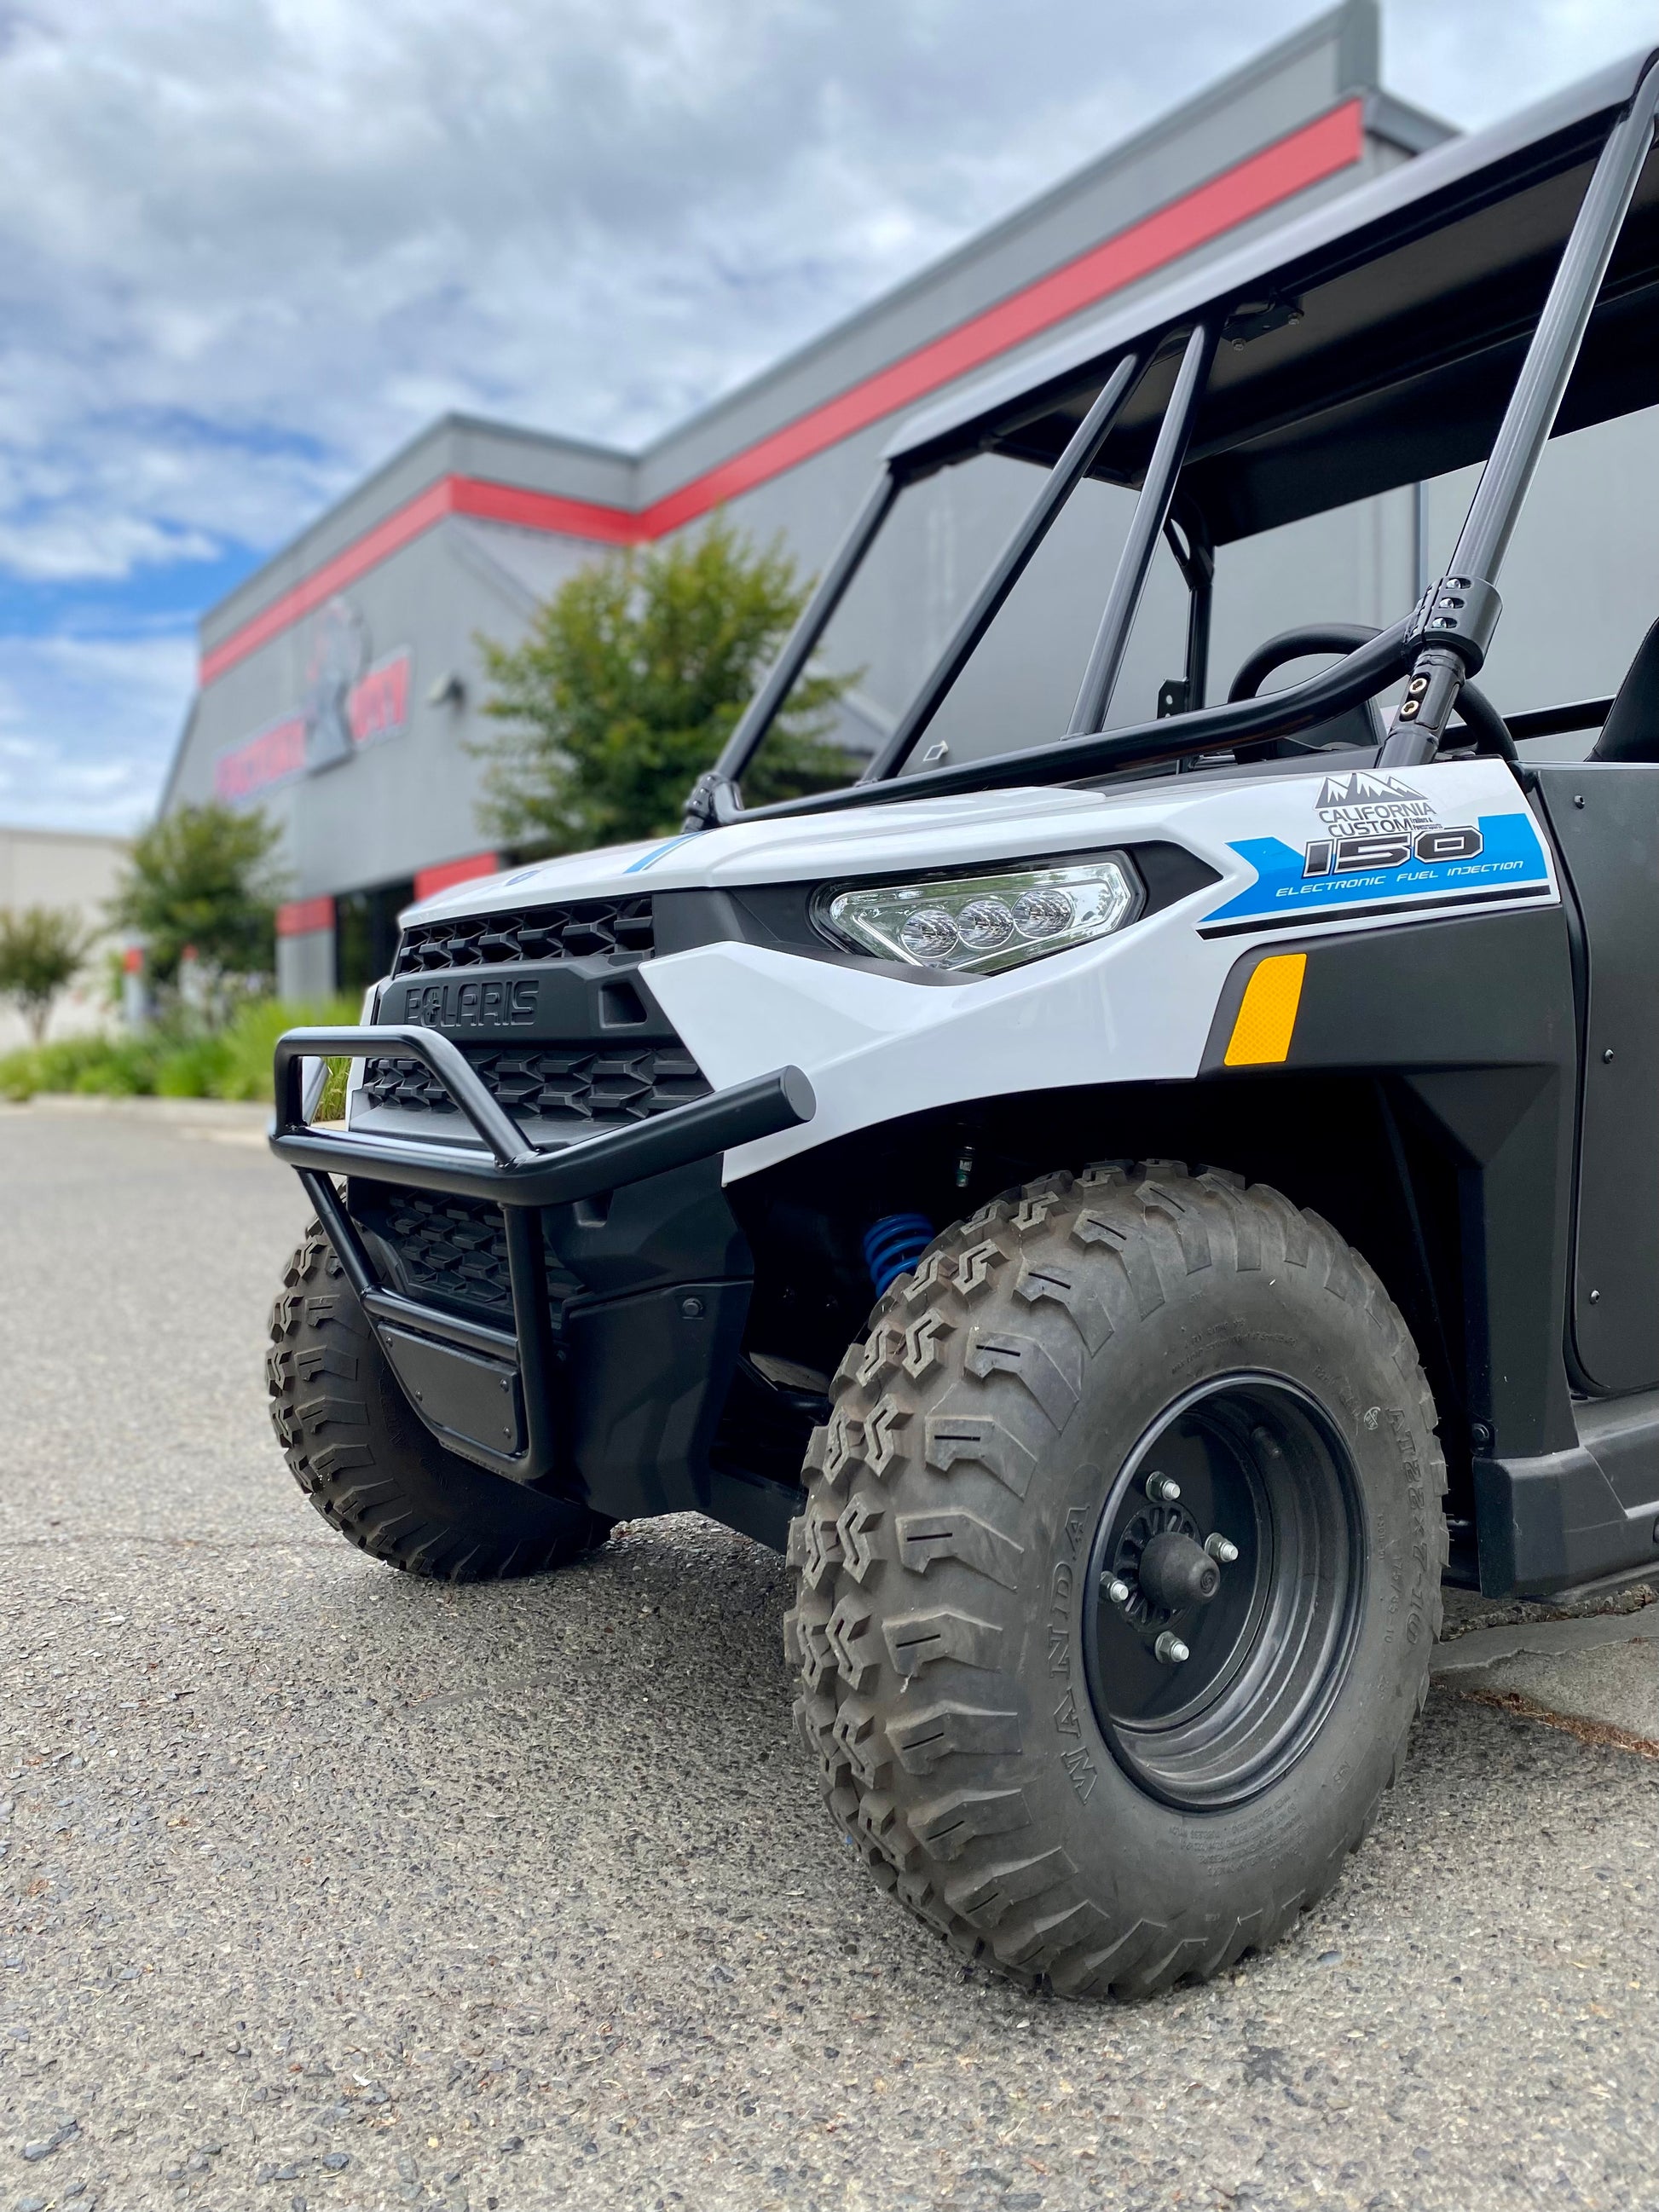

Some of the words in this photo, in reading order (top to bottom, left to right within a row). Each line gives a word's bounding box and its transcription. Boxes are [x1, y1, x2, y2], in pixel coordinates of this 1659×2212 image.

[1318, 801, 1437, 824] CALIFORNIA
[1327, 817, 1413, 838] CUSTOM
[1301, 825, 1484, 880] 150
[1275, 875, 1387, 898] ELECTRONIC
[1396, 870, 1439, 882] FUEL
[1447, 860, 1524, 876] INJECTION
[404, 979, 540, 1029] POLARIS
[1047, 1505, 1099, 1806] WANDA
